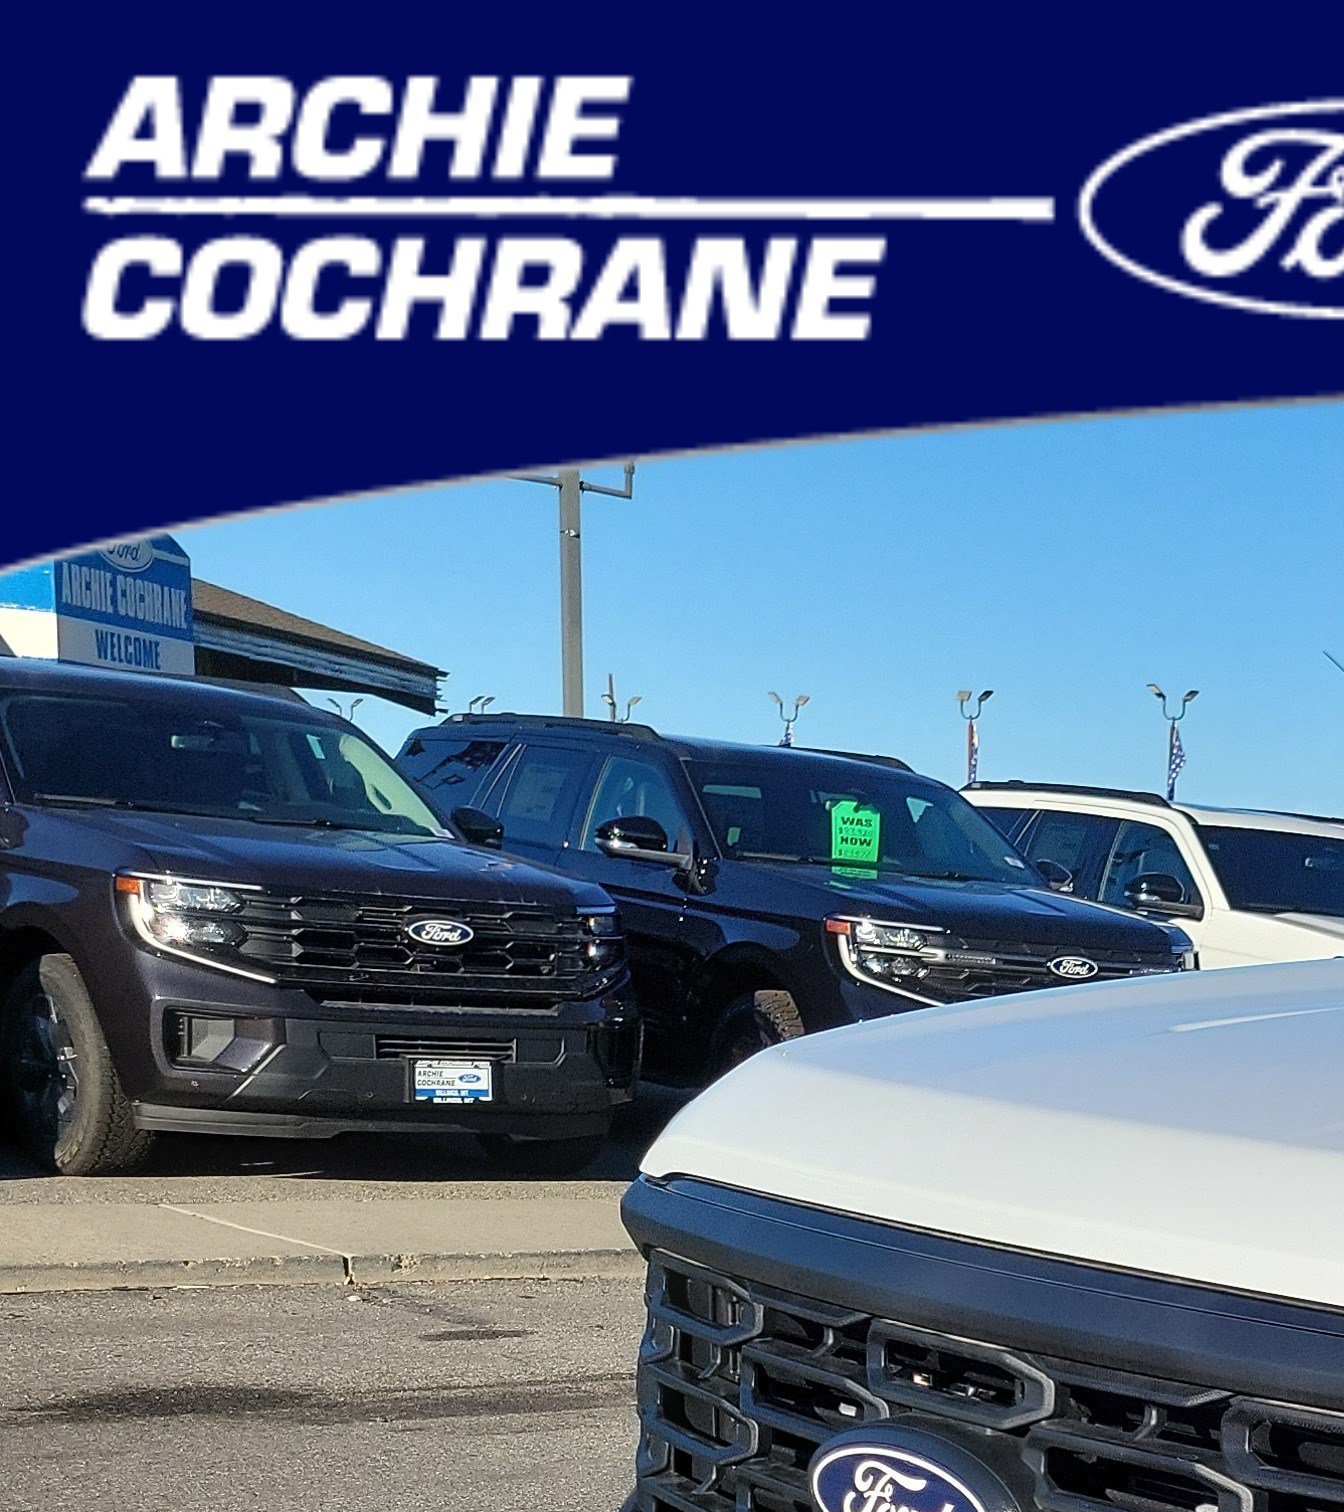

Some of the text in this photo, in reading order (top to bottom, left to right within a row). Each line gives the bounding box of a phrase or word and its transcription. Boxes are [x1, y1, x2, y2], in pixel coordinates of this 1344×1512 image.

[62, 562, 188, 630] ARCHIE COCHRANE
[95, 629, 161, 671] WELCOME
[841, 816, 873, 828] WAS
[840, 836, 873, 847] NOW
[421, 923, 462, 941] Ford
[1059, 959, 1089, 975] Ford
[417, 1079, 456, 1087] COCHRANE
